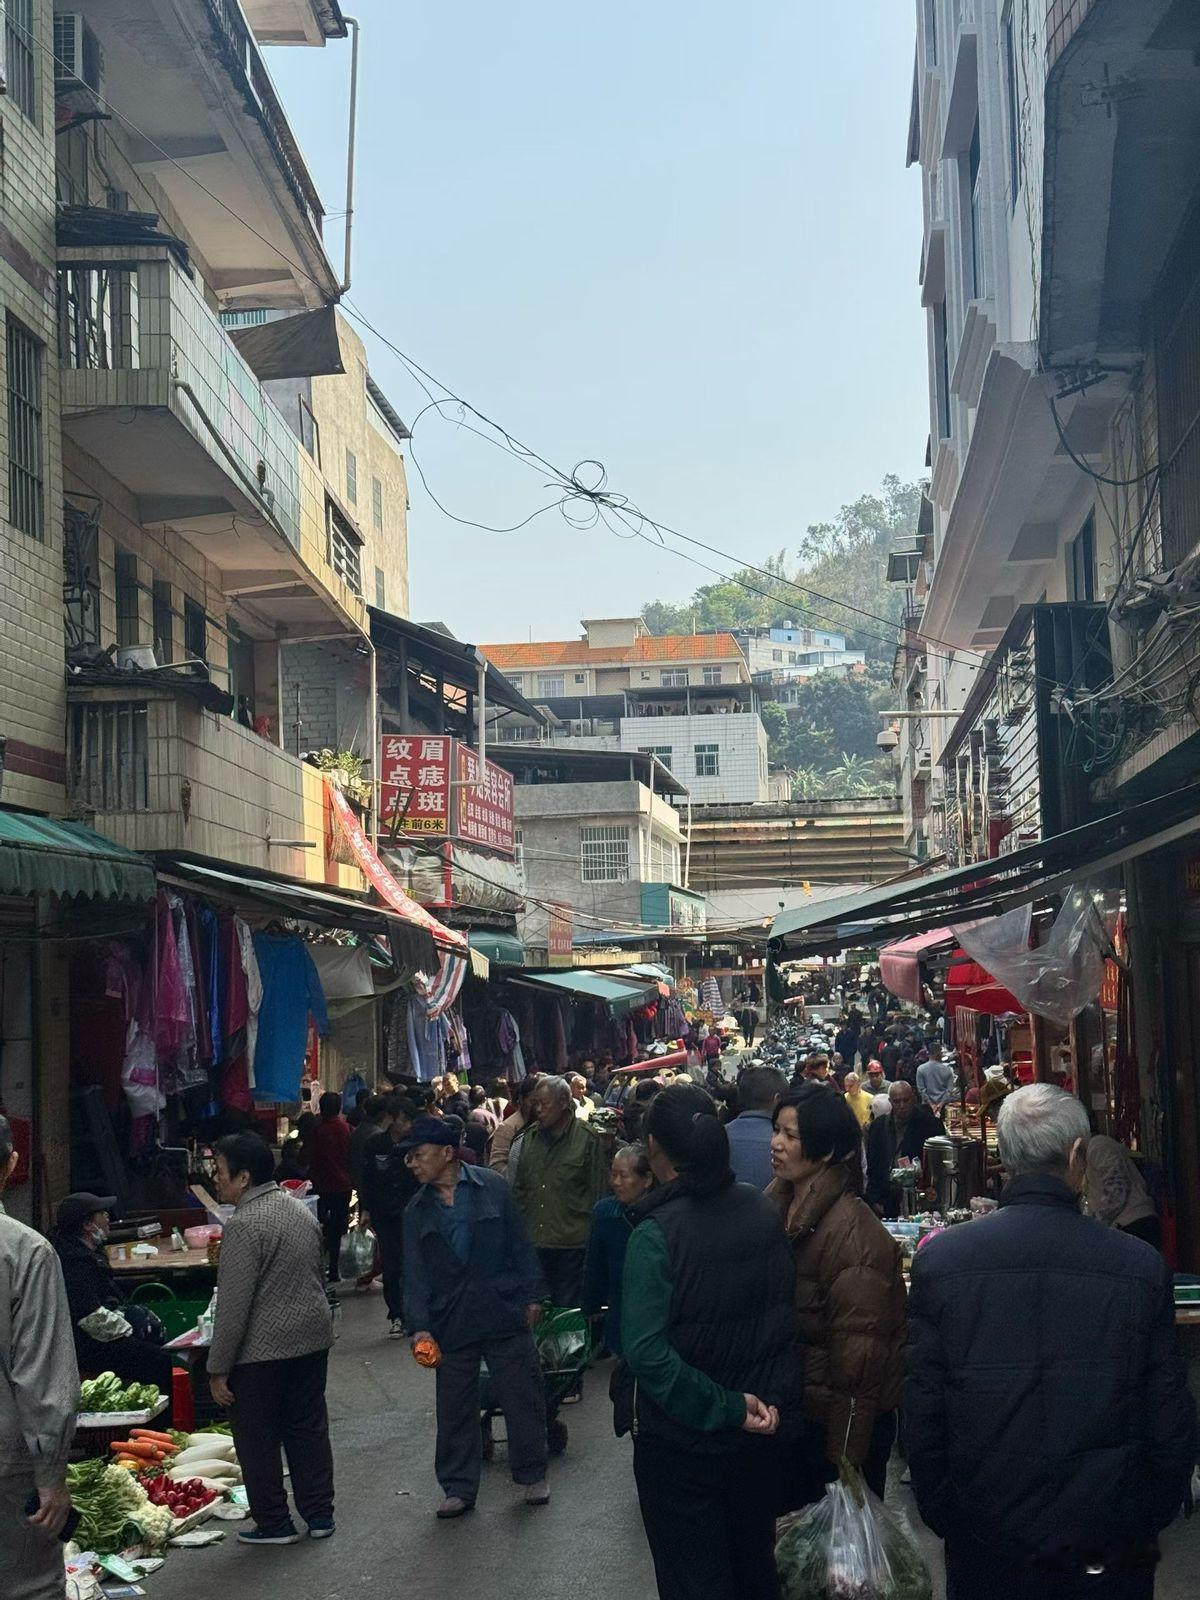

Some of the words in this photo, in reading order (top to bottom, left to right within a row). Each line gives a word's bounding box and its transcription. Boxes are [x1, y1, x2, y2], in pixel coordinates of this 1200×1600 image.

[386, 738, 444, 761] 纹眉
[386, 764, 444, 787] 点痣
[385, 790, 444, 812] 点斑
